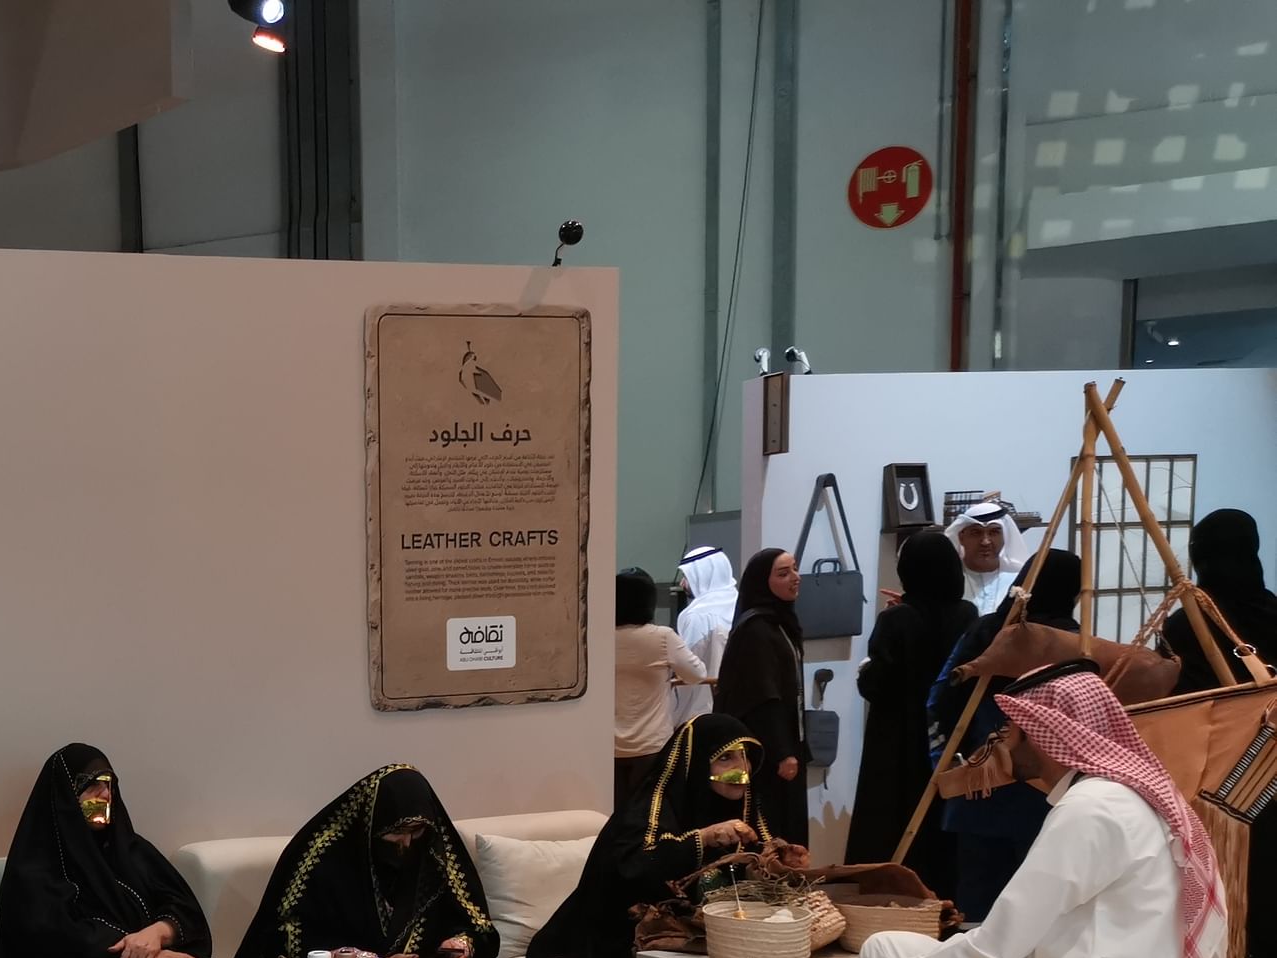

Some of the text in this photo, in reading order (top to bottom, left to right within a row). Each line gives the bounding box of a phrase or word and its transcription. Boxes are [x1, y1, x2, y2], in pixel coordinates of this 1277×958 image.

[428, 421, 532, 448] حرف الجلود
[400, 529, 559, 551] LEATHER CRAFTS
